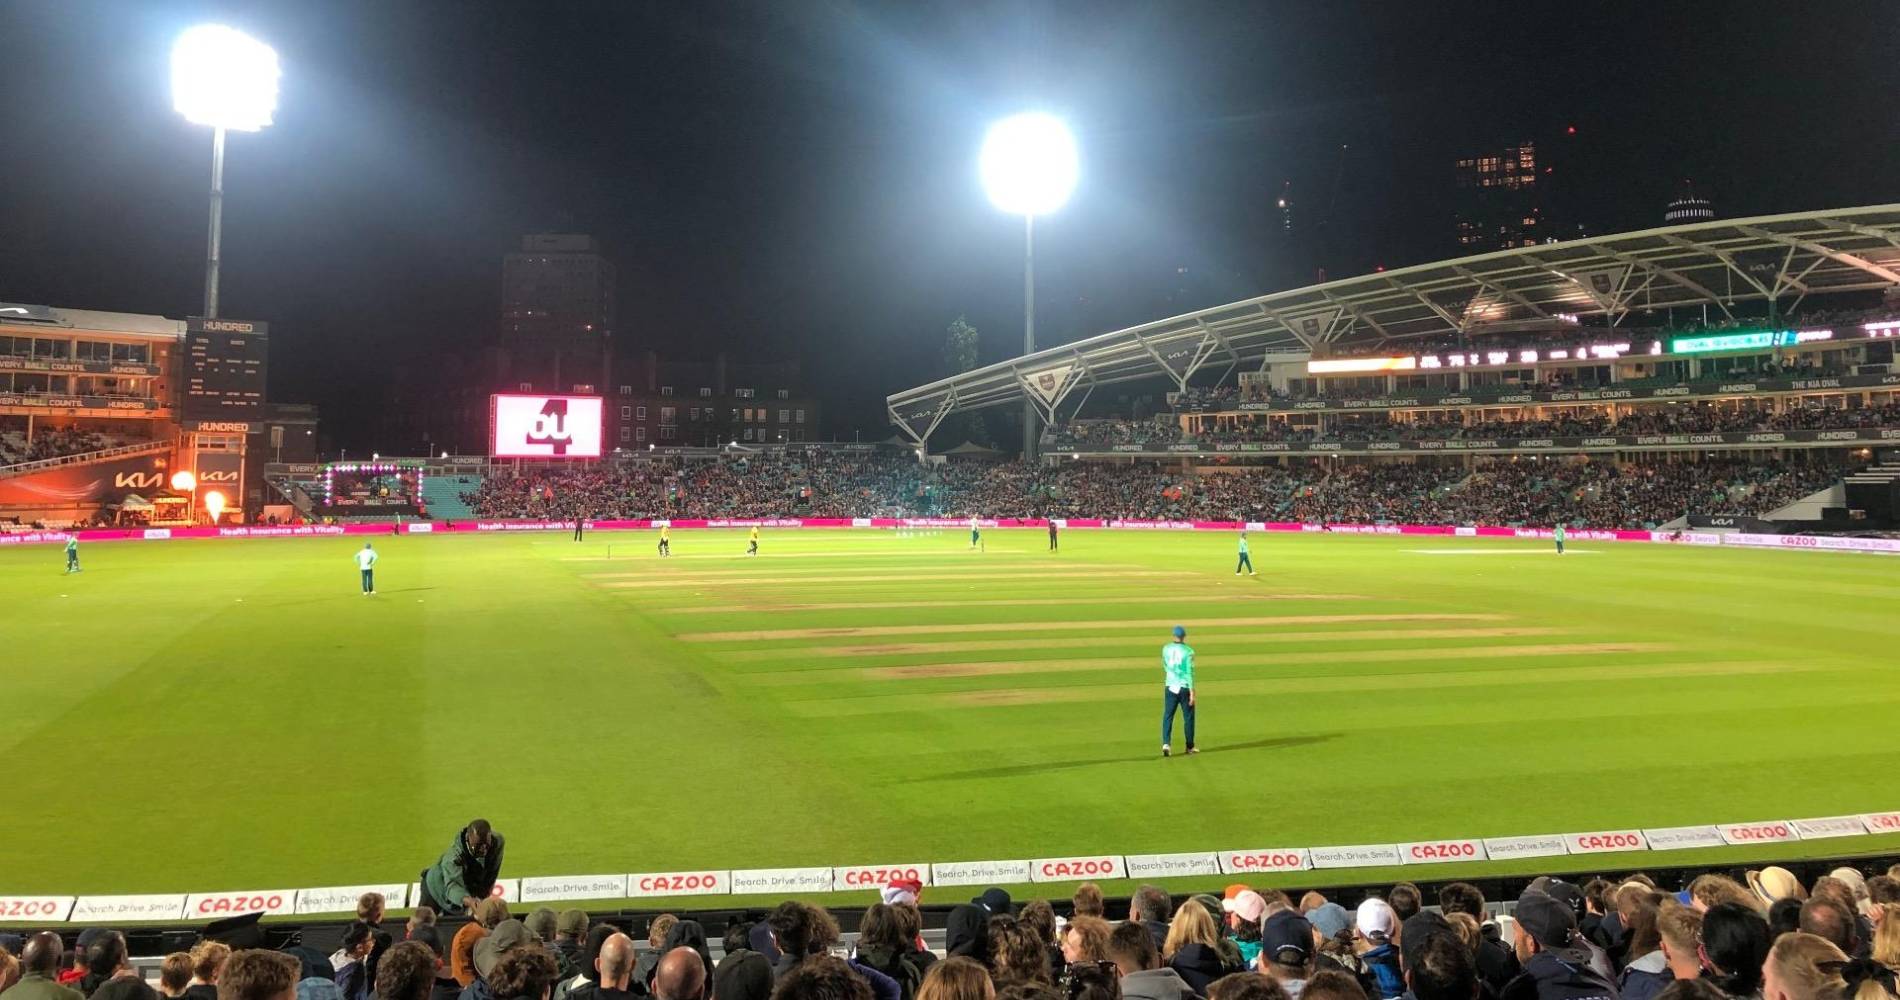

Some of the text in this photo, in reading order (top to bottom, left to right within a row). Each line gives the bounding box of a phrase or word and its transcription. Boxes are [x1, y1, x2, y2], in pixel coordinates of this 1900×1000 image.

[203, 321, 253, 332] HUNDRED
[111, 366, 147, 374] HUNDRED
[1719, 384, 1756, 392] HUNDRED
[1792, 381, 1806, 389] THE
[1822, 379, 1840, 387] OVAL
[1438, 397, 1472, 405] HUNDRED
[1498, 395, 1532, 403] HUNDRED
[198, 422, 248, 432] HUNDRED
[1747, 434, 1785, 442] HUNDRED
[1818, 431, 1858, 440] HUNDRED
[1368, 442, 1400, 450] HUNDRED
[1519, 439, 1553, 447] HUNDRED
[1583, 438, 1617, 446] HUNDRED
[220, 525, 345, 536] Health insurance with Vitality
[478, 522, 504, 530] Health
[1781, 537, 1817, 546] CAZOO
[1731, 826, 1787, 839] CAZOO
[1578, 835, 1639, 848] CAZOO
[1411, 843, 1475, 858] CAZOO
[1232, 854, 1299, 868] CAZOO
[1042, 860, 1113, 877] CAZOO
[845, 868, 918, 884] CAZOO
[640, 874, 716, 891] CAZOO
[198, 895, 283, 912] CAZOO
